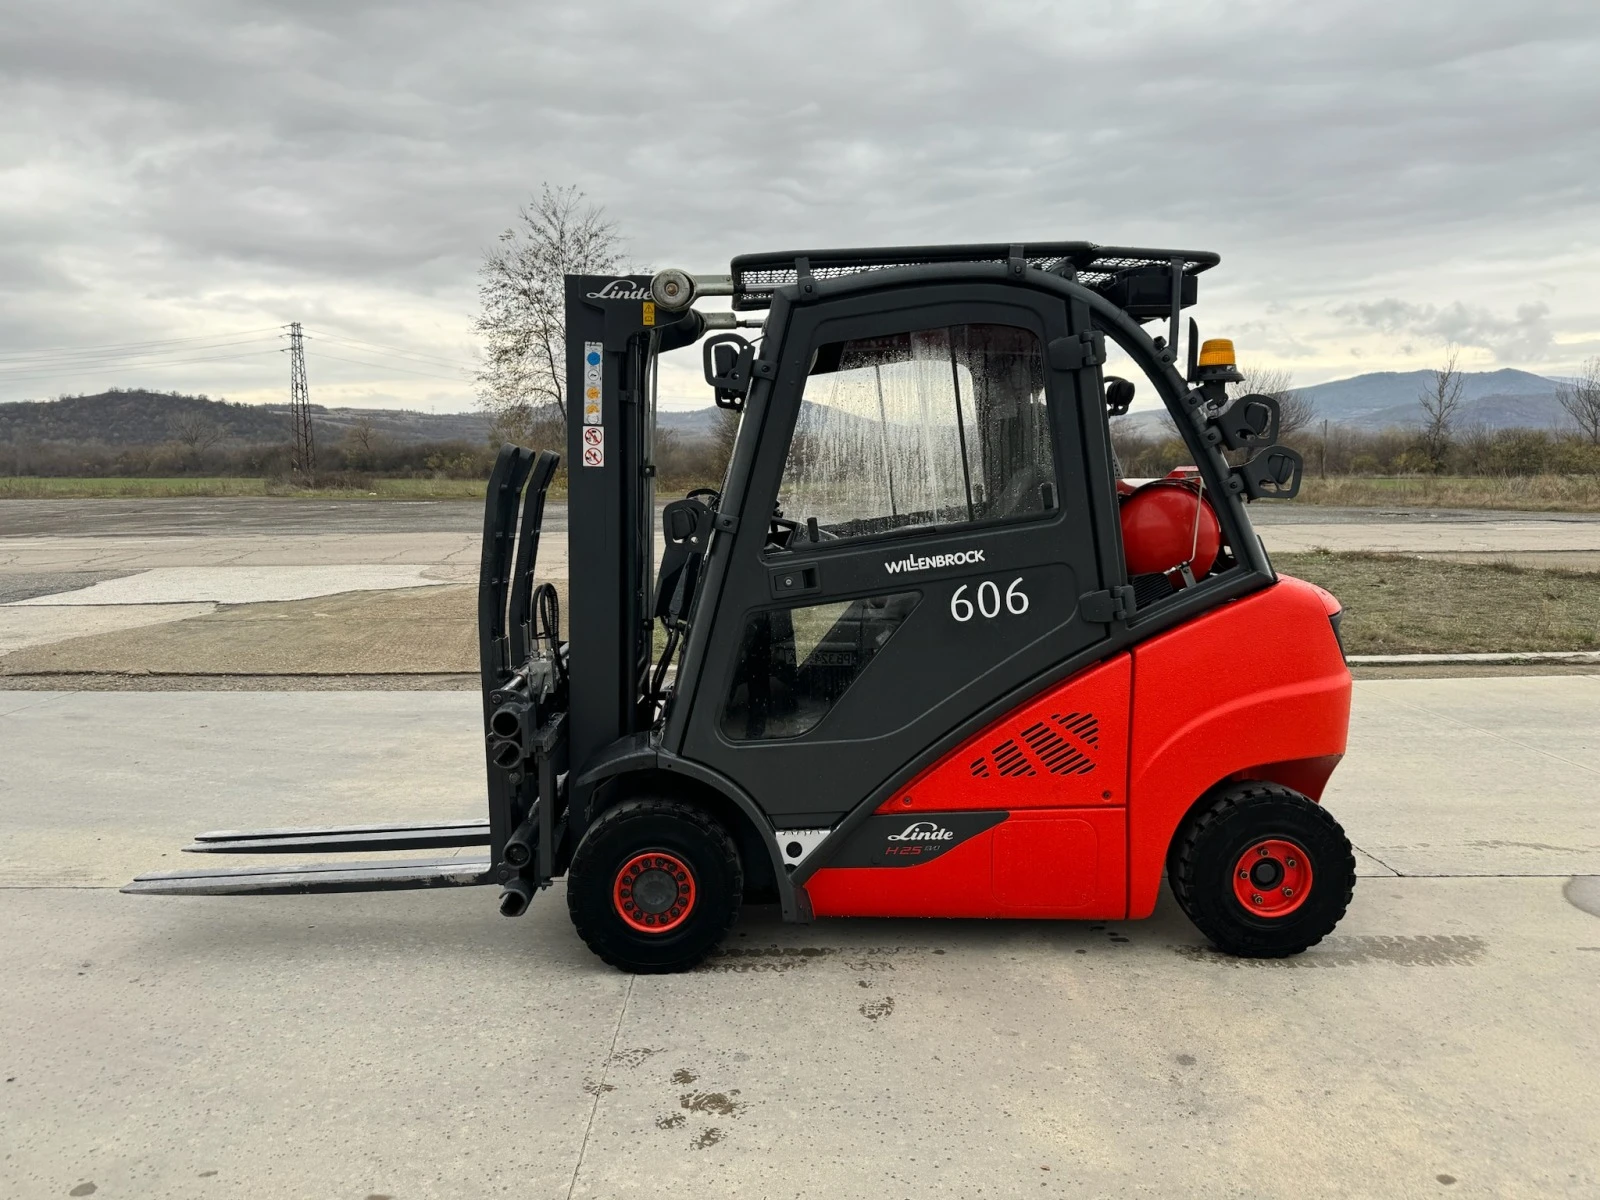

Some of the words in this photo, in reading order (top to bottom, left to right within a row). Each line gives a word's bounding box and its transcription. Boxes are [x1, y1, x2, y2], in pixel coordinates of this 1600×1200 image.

[586, 279, 653, 300] Linde
[885, 550, 986, 574] WILLENBROCK
[951, 576, 1030, 622] 606
[887, 821, 954, 841] Linde
